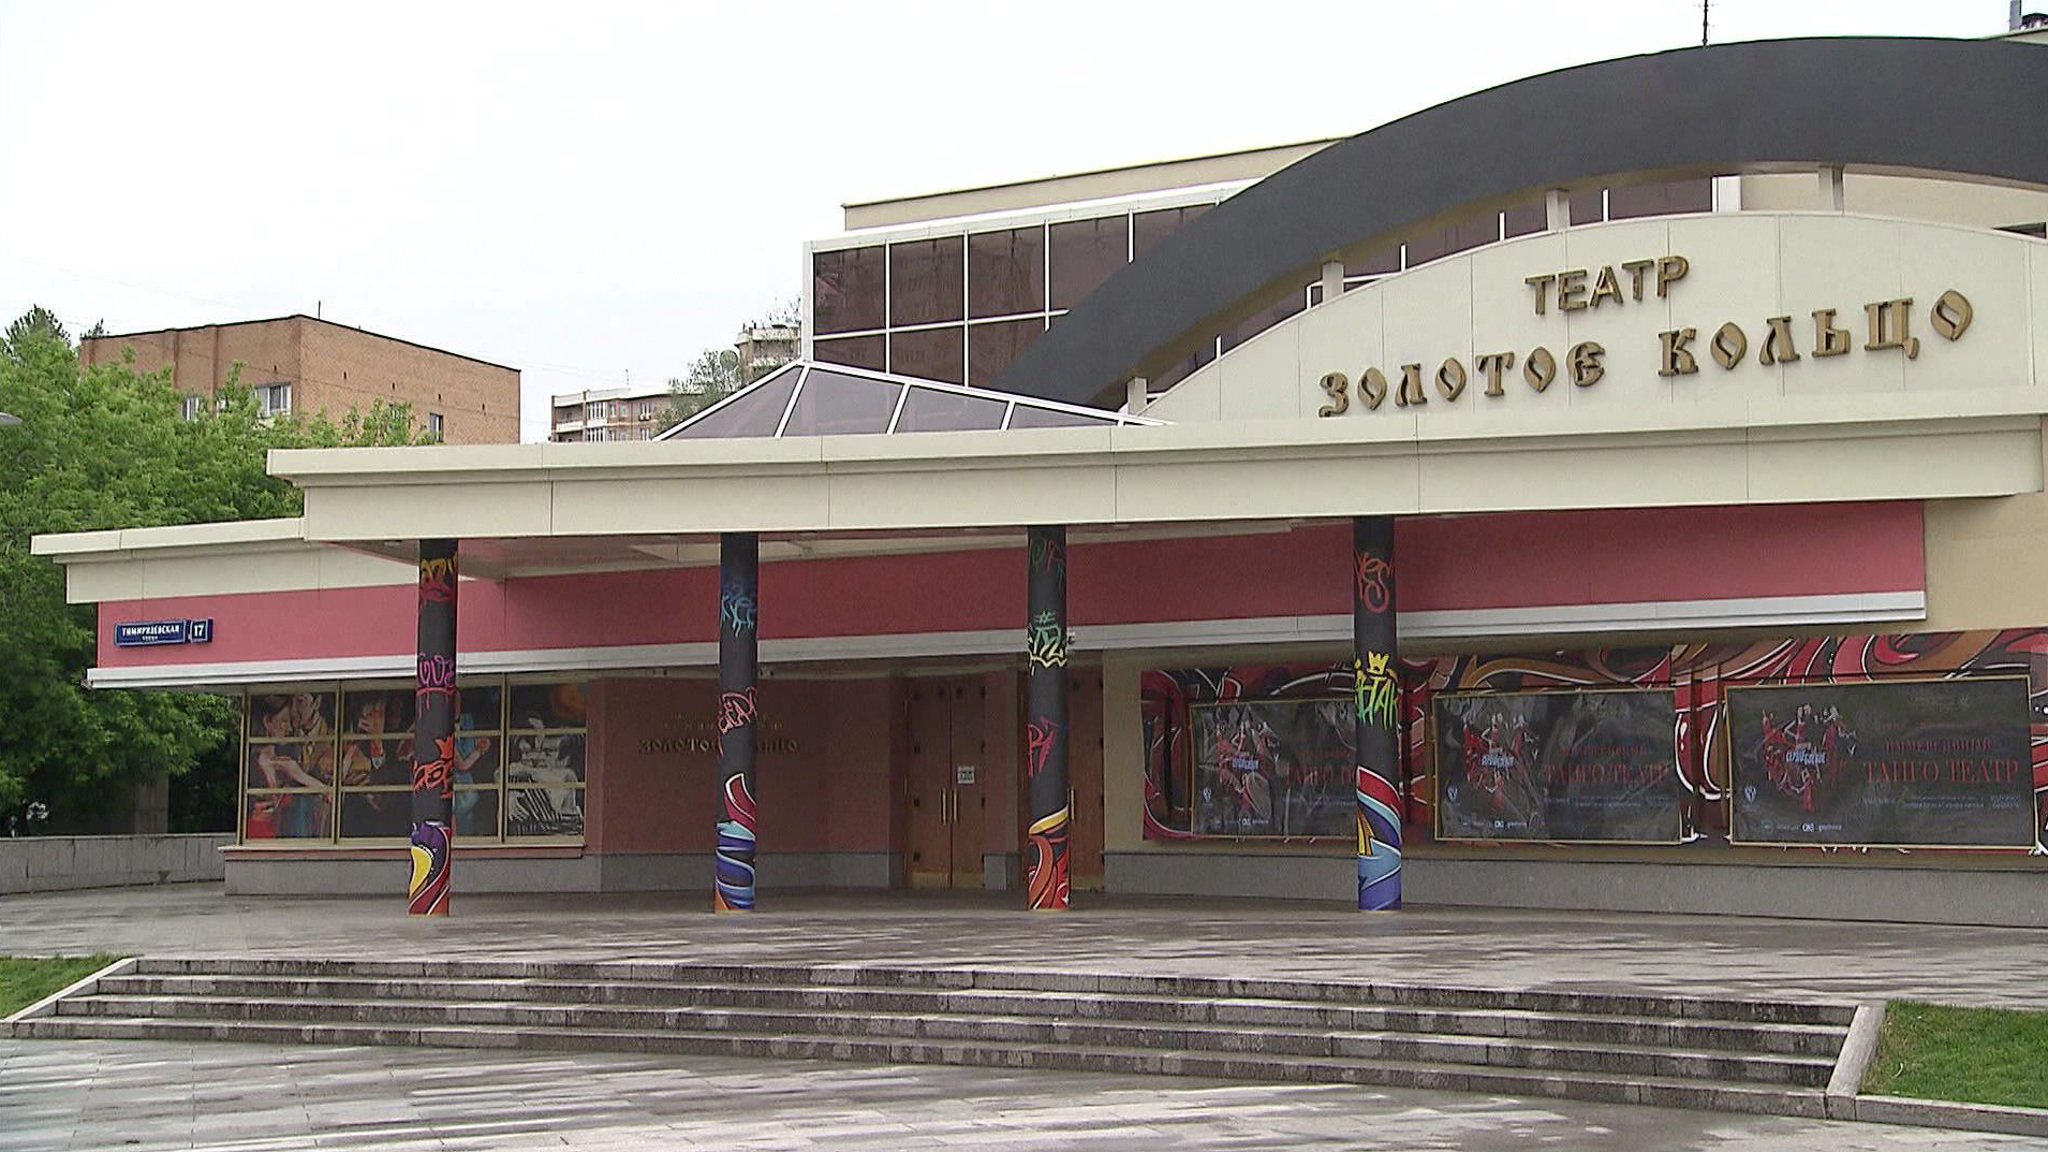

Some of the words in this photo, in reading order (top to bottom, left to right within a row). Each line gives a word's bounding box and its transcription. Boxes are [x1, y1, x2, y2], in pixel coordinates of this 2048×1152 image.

[1525, 255, 1690, 316] ТЕАТР
[1317, 340, 1606, 418] ЗОЛОТОЕ
[1657, 288, 1974, 378] КОЛЬЦО
[193, 624, 205, 637] 17
